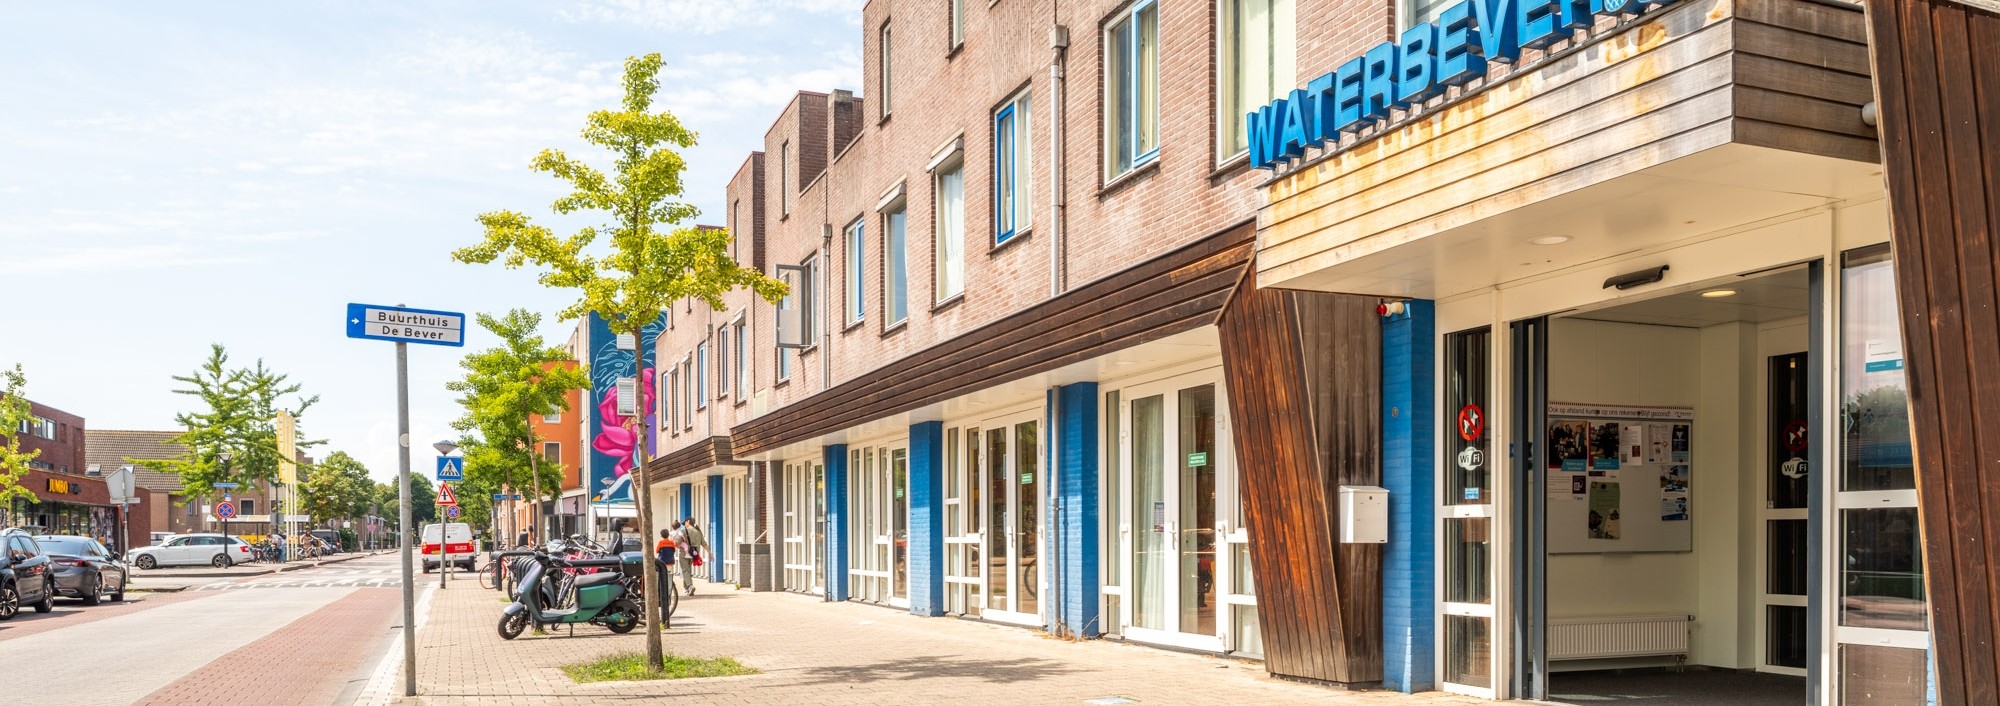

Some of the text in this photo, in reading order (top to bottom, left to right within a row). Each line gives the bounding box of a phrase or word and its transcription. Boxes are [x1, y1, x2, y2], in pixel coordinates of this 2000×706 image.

[378, 311, 448, 327] Buurthuis
[382, 325, 444, 339] De Bever
[49, 478, 69, 494] JUMBO
